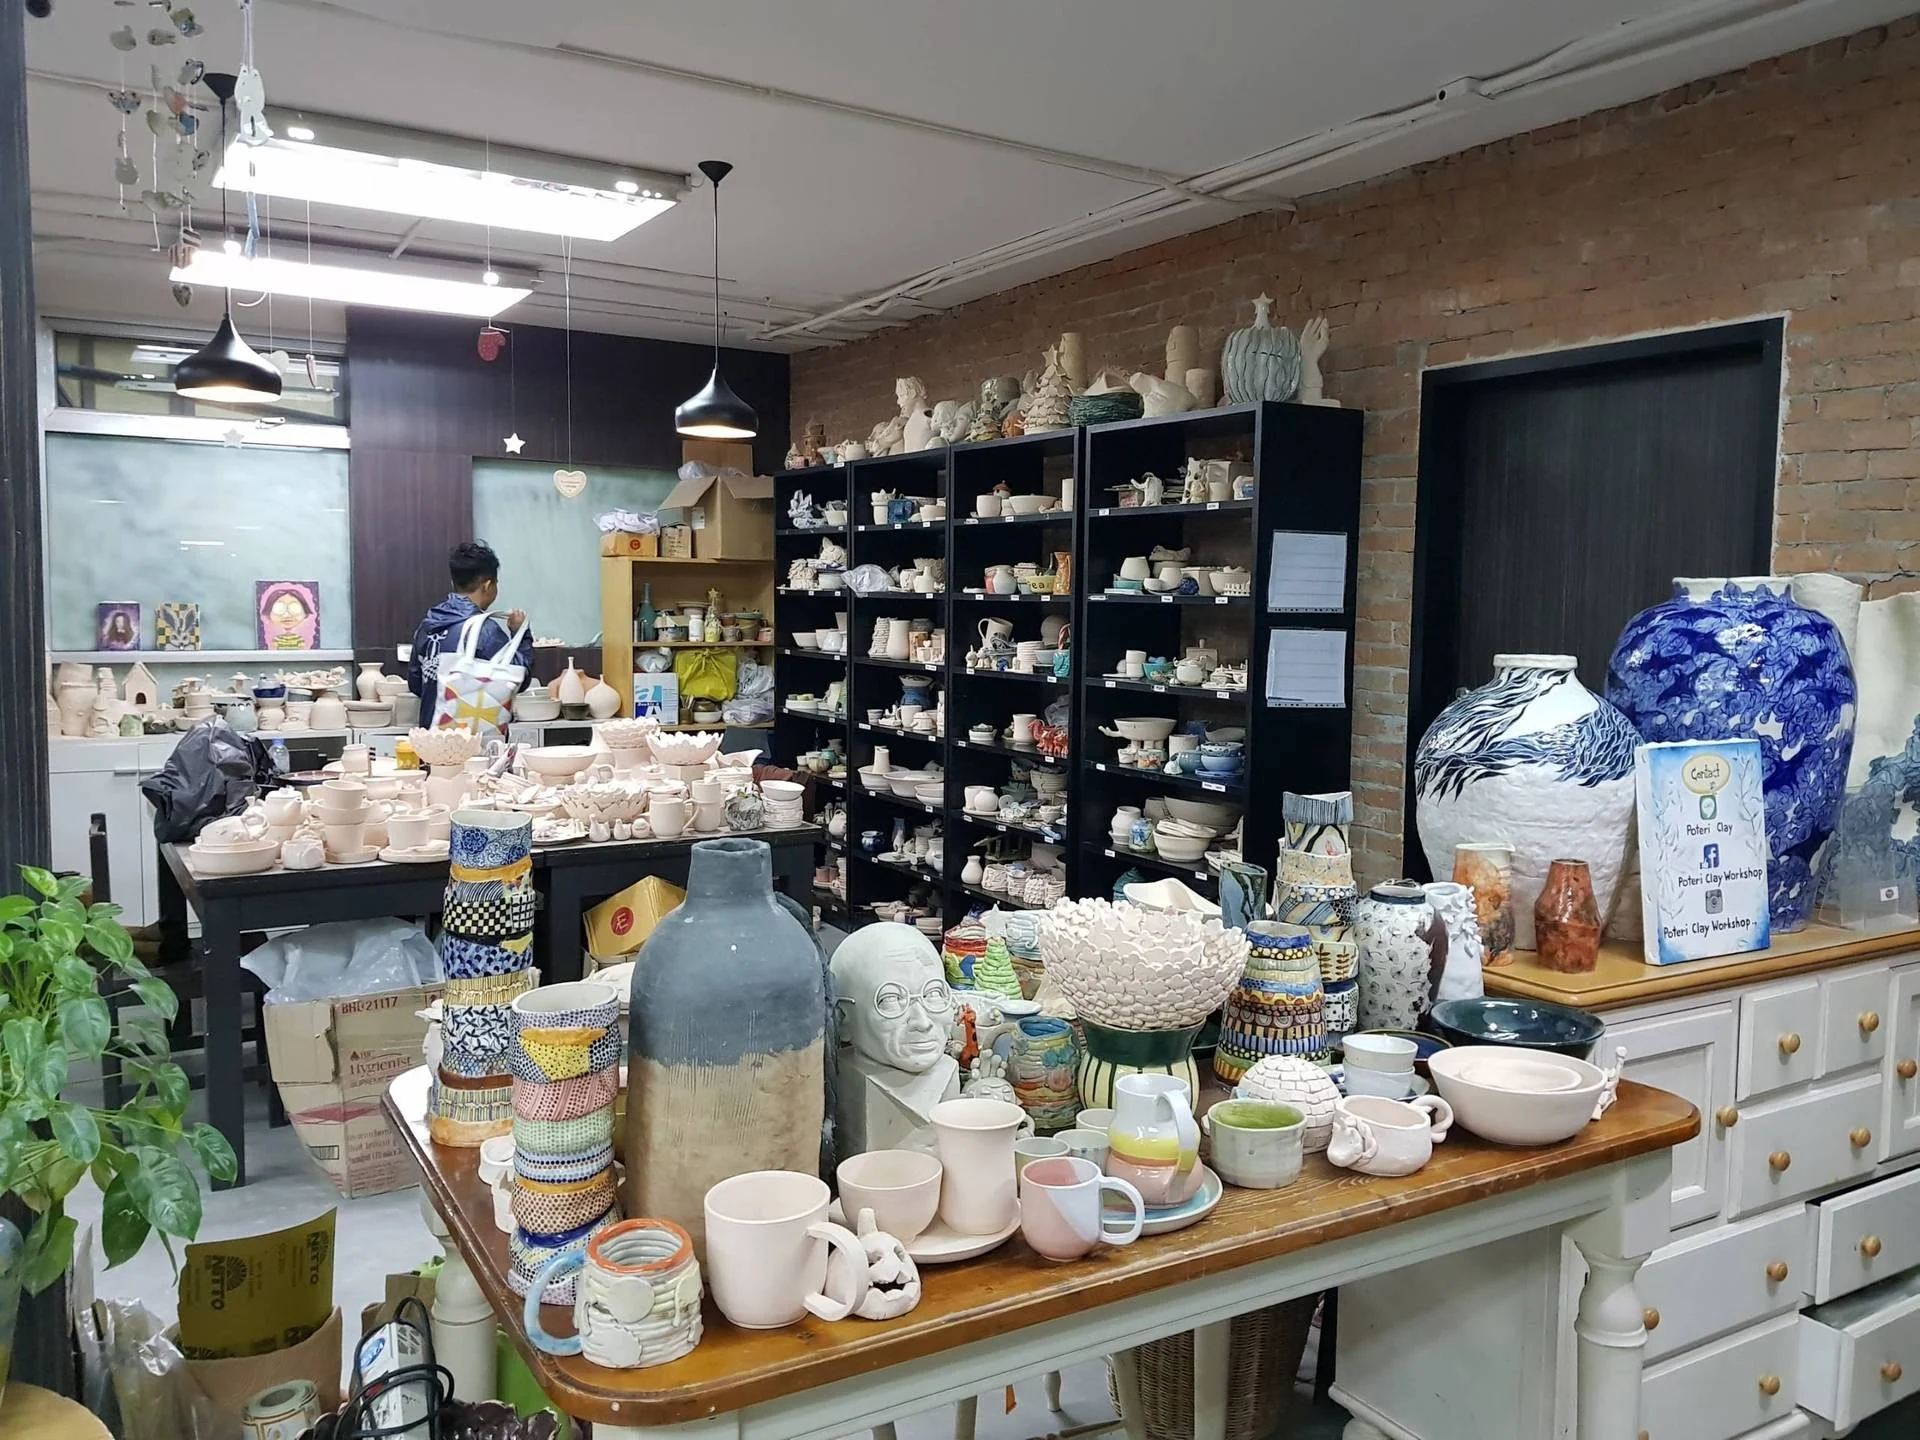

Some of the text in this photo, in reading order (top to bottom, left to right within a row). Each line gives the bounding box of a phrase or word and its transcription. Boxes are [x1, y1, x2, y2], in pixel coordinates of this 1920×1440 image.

[1691, 763, 1720, 780] Contact
[1686, 822, 1733, 836] Poteri Clay
[1678, 867, 1763, 887] Poteri Clay Workshop
[1663, 923, 1688, 938] Poteri
[1691, 921, 1710, 938] Clay
